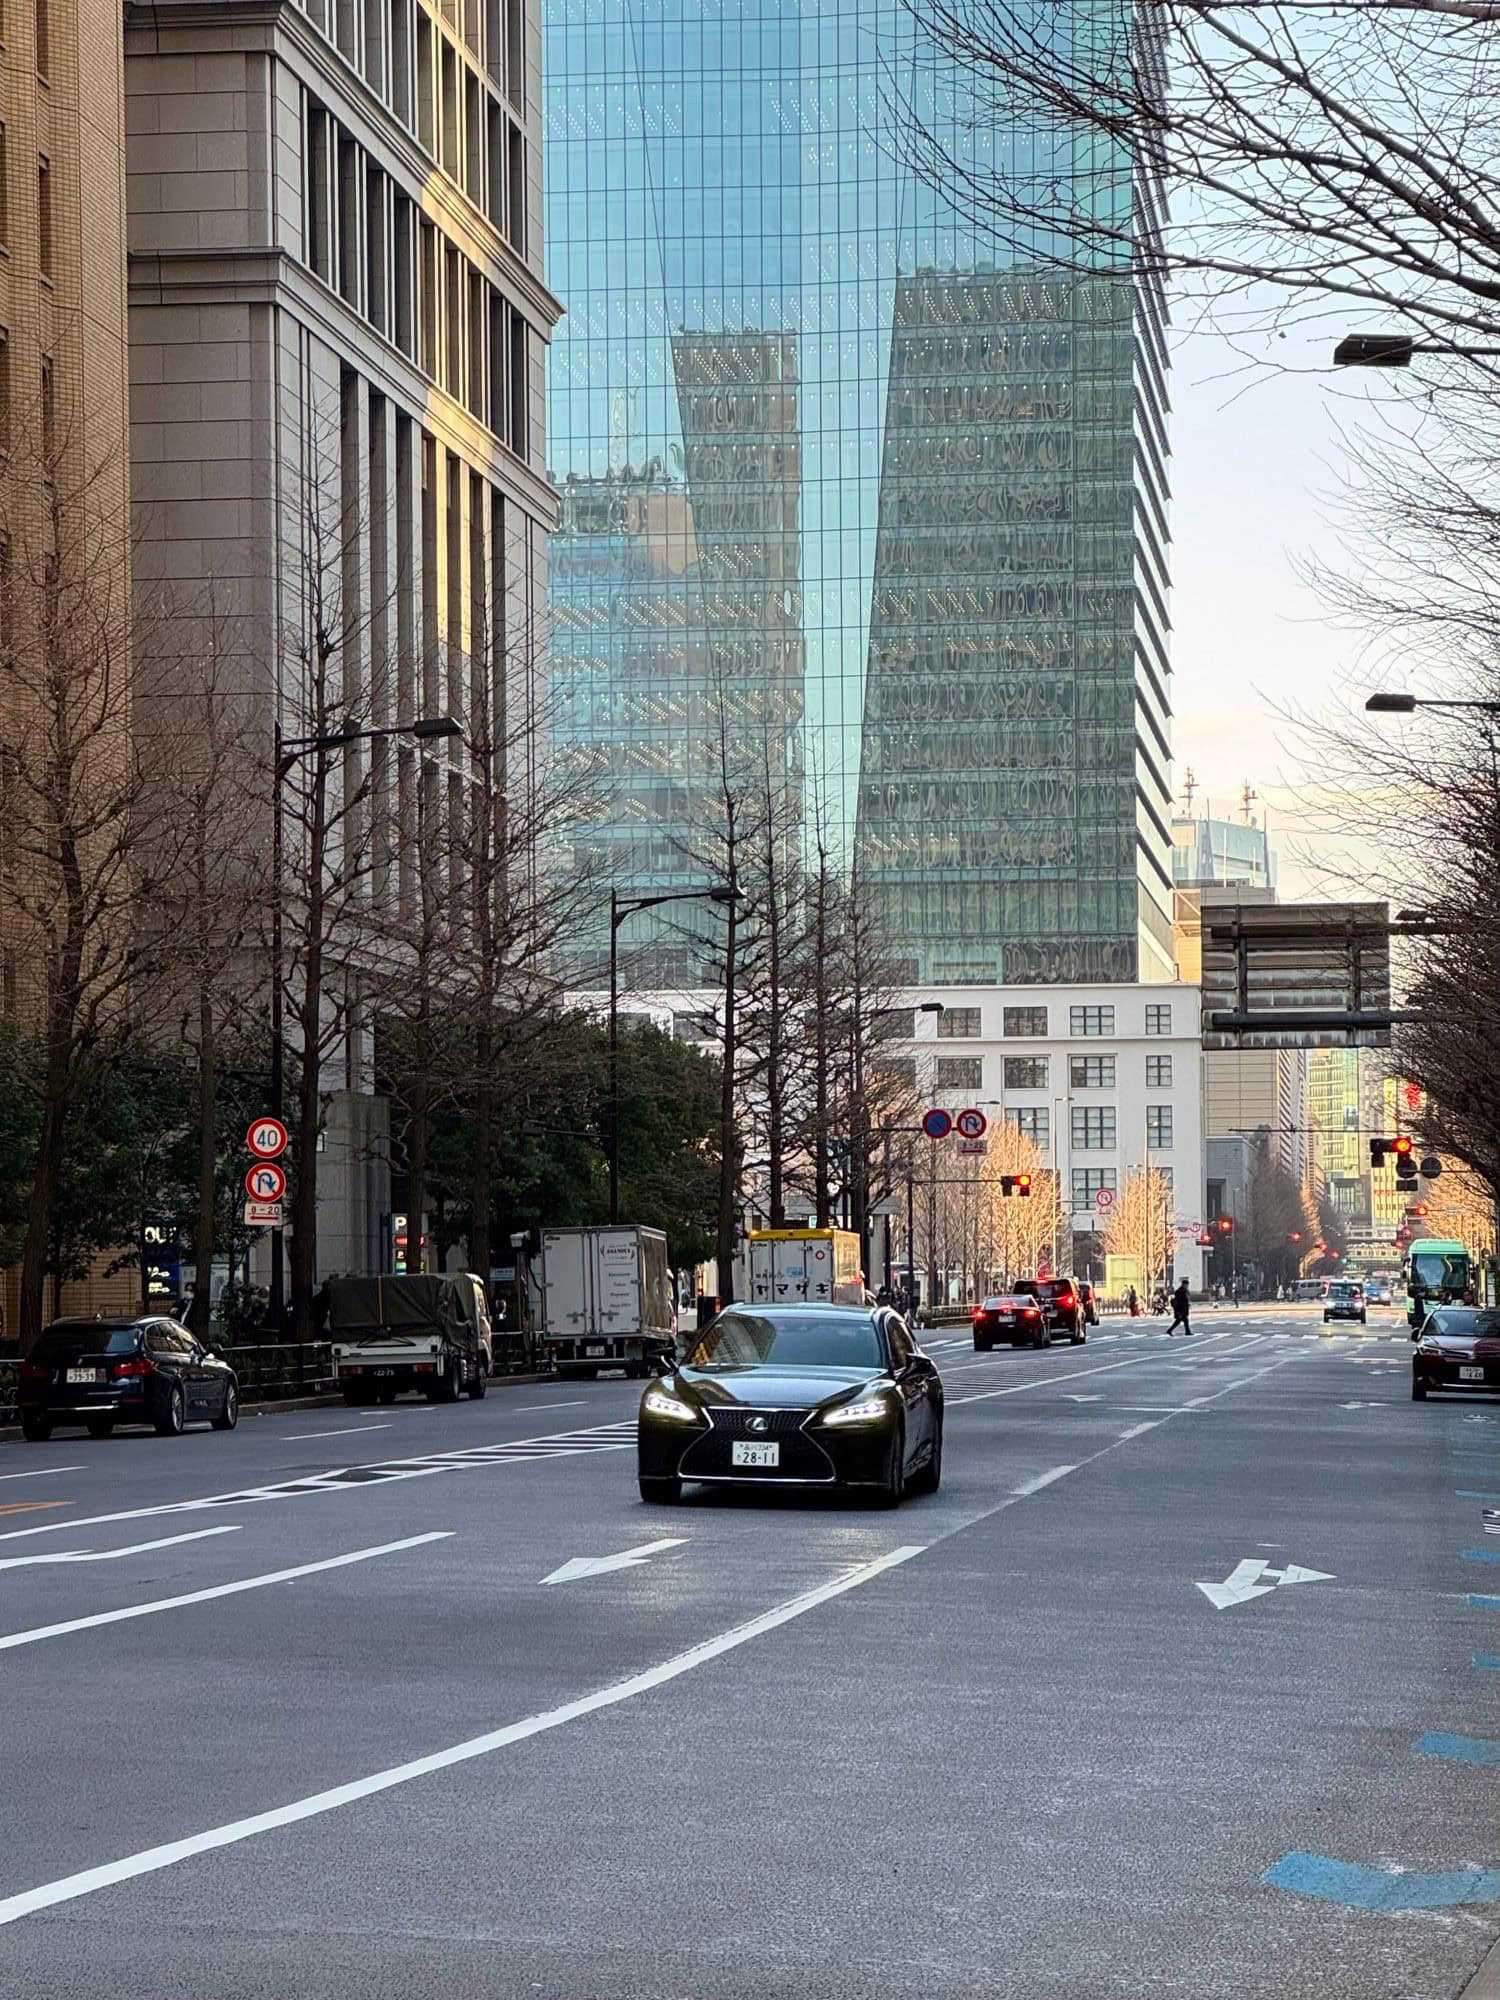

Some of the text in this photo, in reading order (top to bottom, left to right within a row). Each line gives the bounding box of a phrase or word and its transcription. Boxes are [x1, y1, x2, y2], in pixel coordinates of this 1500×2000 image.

[257, 1130, 278, 1147] 40
[395, 1216, 407, 1231] P
[756, 1283, 829, 1296] ヤマザキ
[743, 1452, 775, 1464] 28-11
